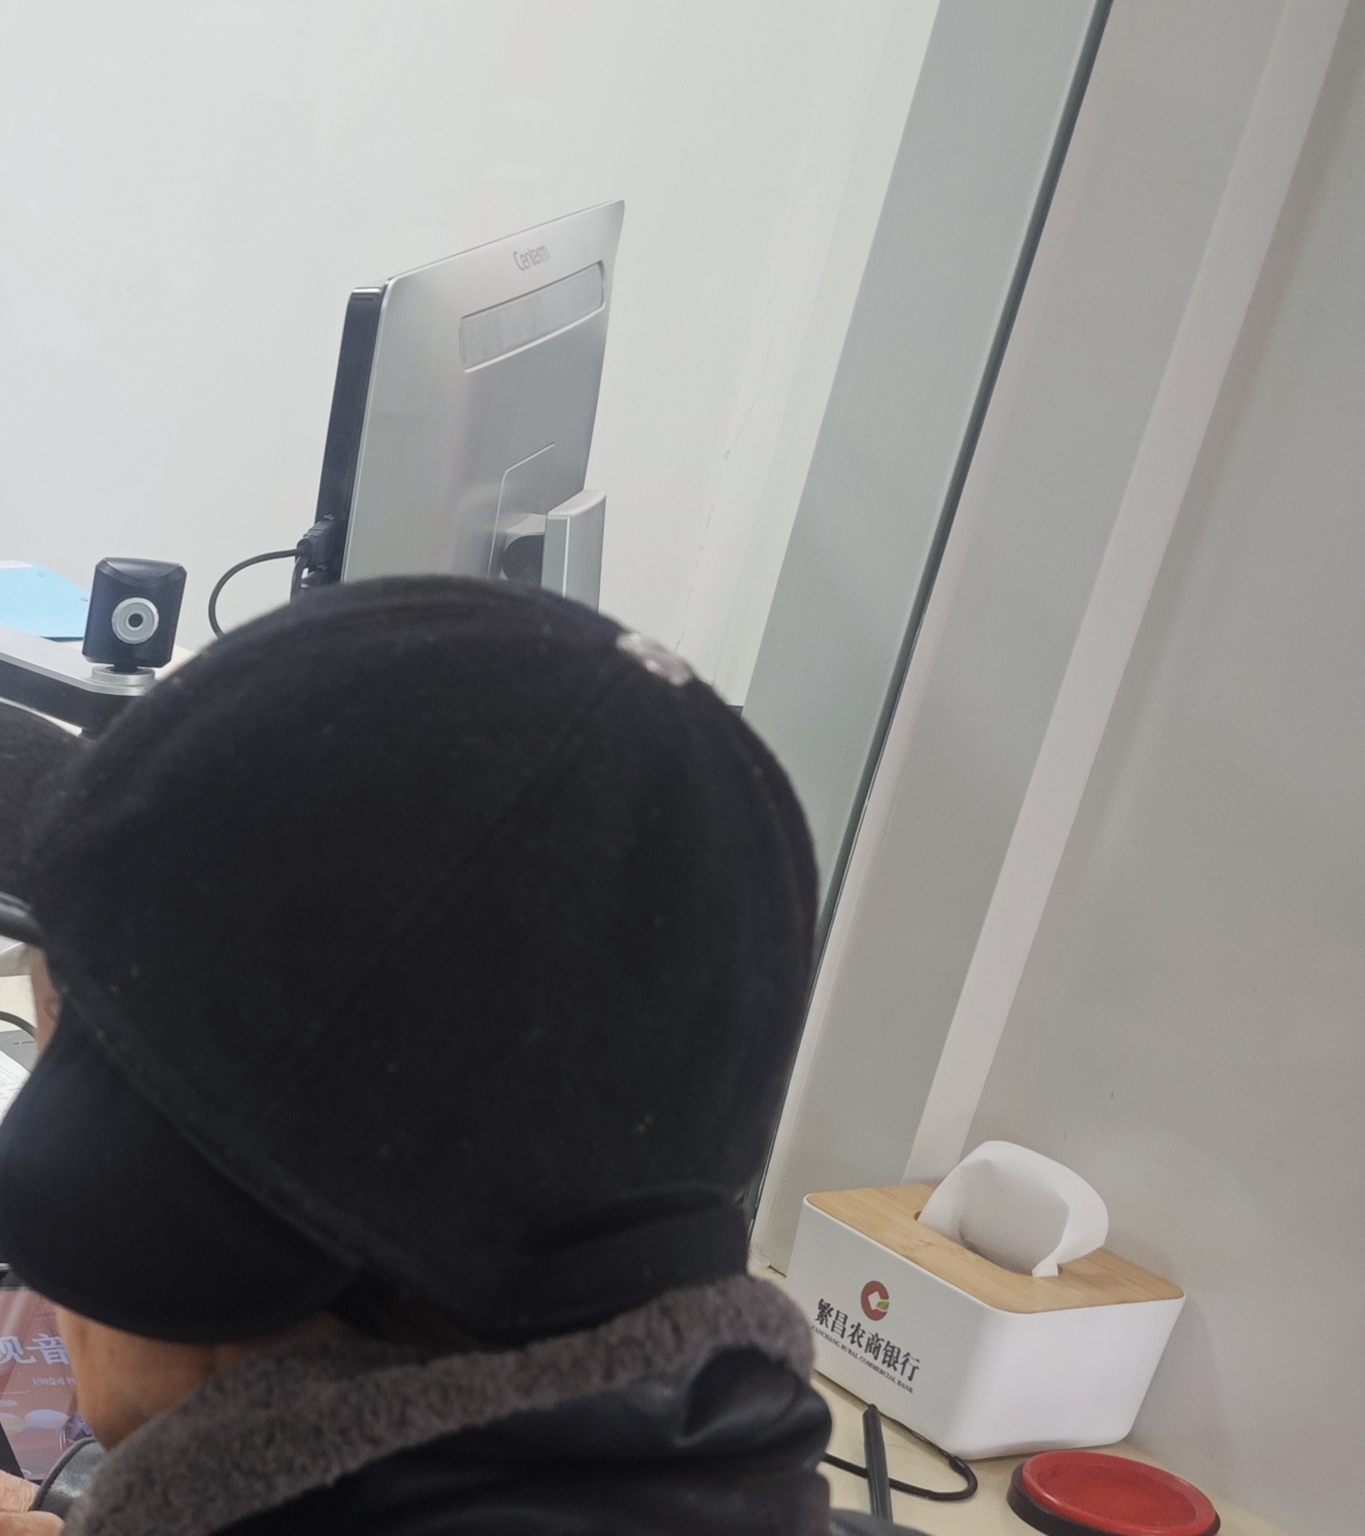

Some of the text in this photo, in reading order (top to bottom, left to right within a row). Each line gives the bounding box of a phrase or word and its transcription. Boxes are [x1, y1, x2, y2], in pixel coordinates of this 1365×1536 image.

[814, 1298, 921, 1382] 繁昌农商银行
